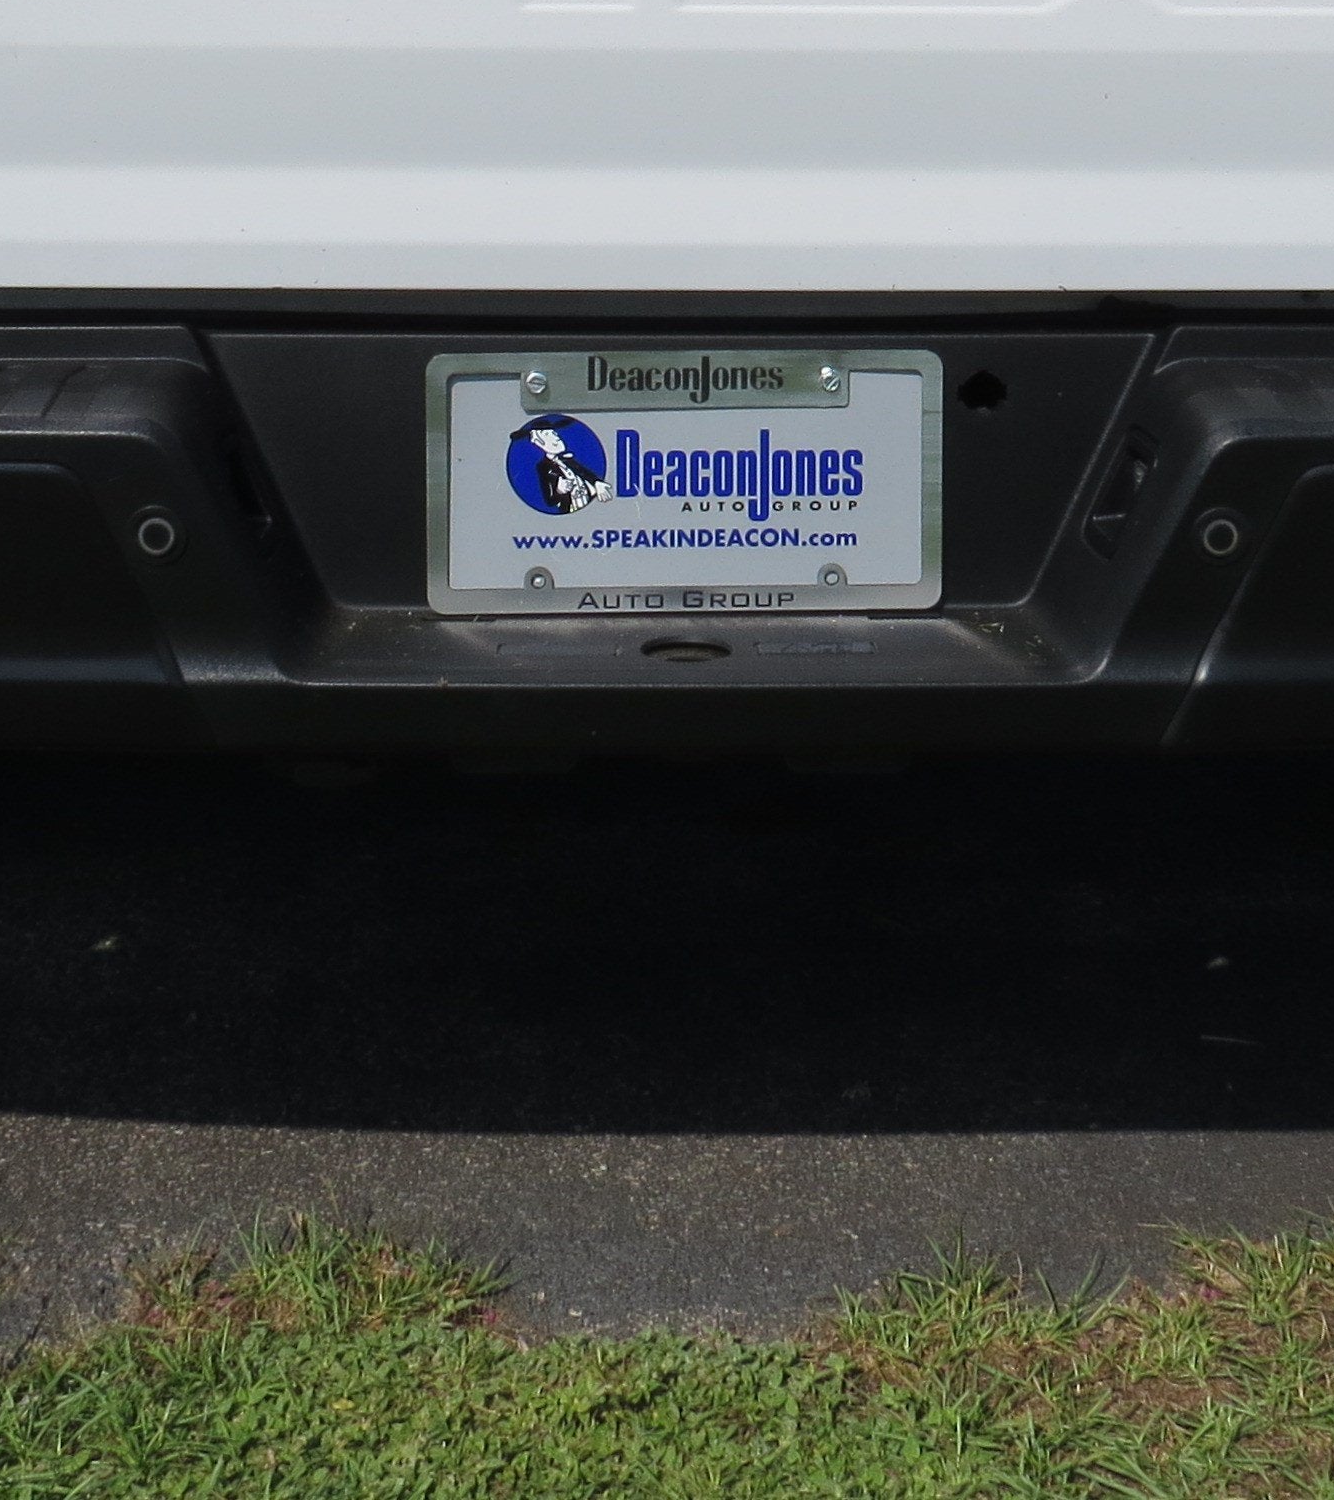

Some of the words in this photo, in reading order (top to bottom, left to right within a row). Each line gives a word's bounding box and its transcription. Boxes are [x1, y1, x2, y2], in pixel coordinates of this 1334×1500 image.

[681, 501, 745, 512] AUTO
[772, 501, 858, 512] GROUP
[513, 528, 858, 549] www.SPEAKINDEACON.com
